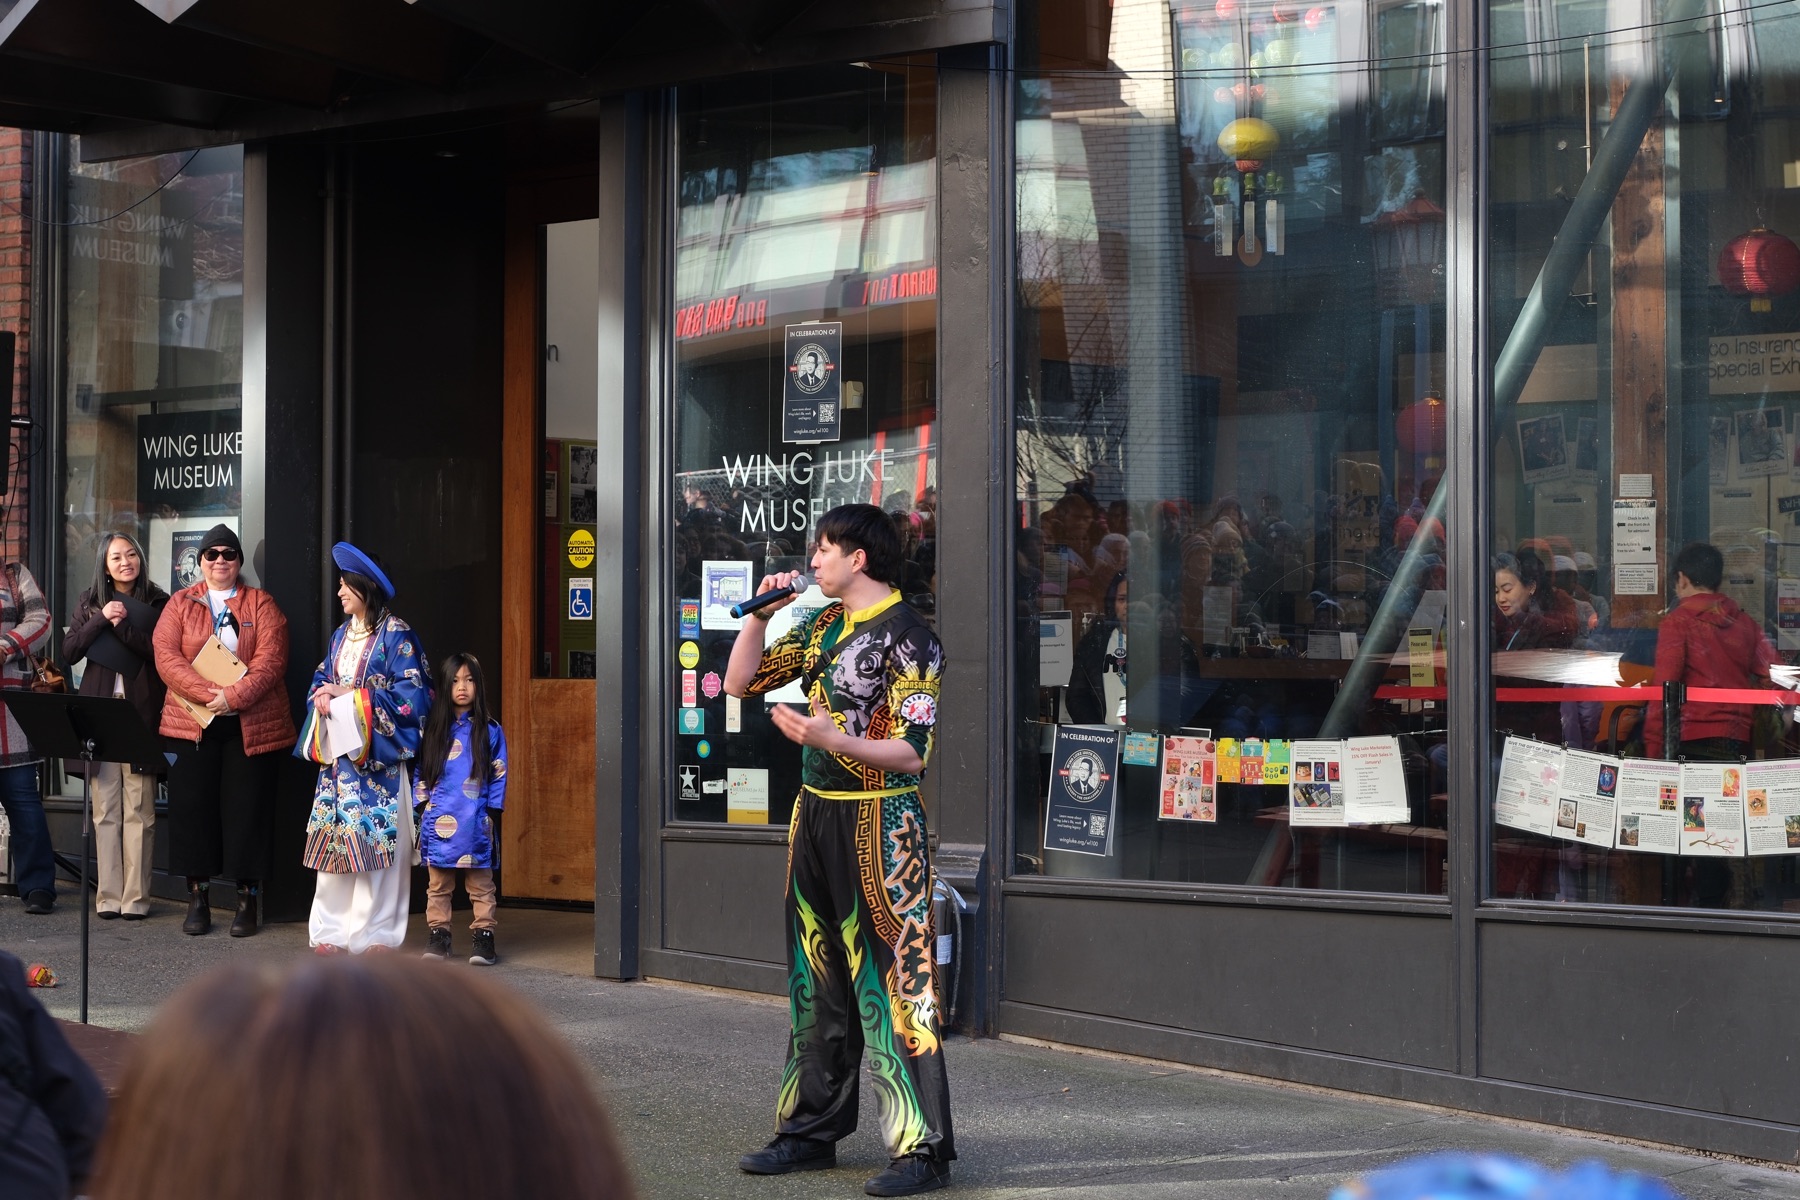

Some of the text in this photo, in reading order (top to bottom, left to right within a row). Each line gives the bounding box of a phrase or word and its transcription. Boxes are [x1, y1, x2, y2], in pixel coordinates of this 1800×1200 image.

[1708, 357, 1765, 381] Special
[144, 432, 243, 460] WING LUKE
[154, 463, 233, 490] MUSEUM
[722, 448, 895, 488] WING LUKE
[740, 496, 873, 533] MUSE
[684, 609, 696, 617] SAFE
[1069, 733, 1105, 743] CELEBRATION
